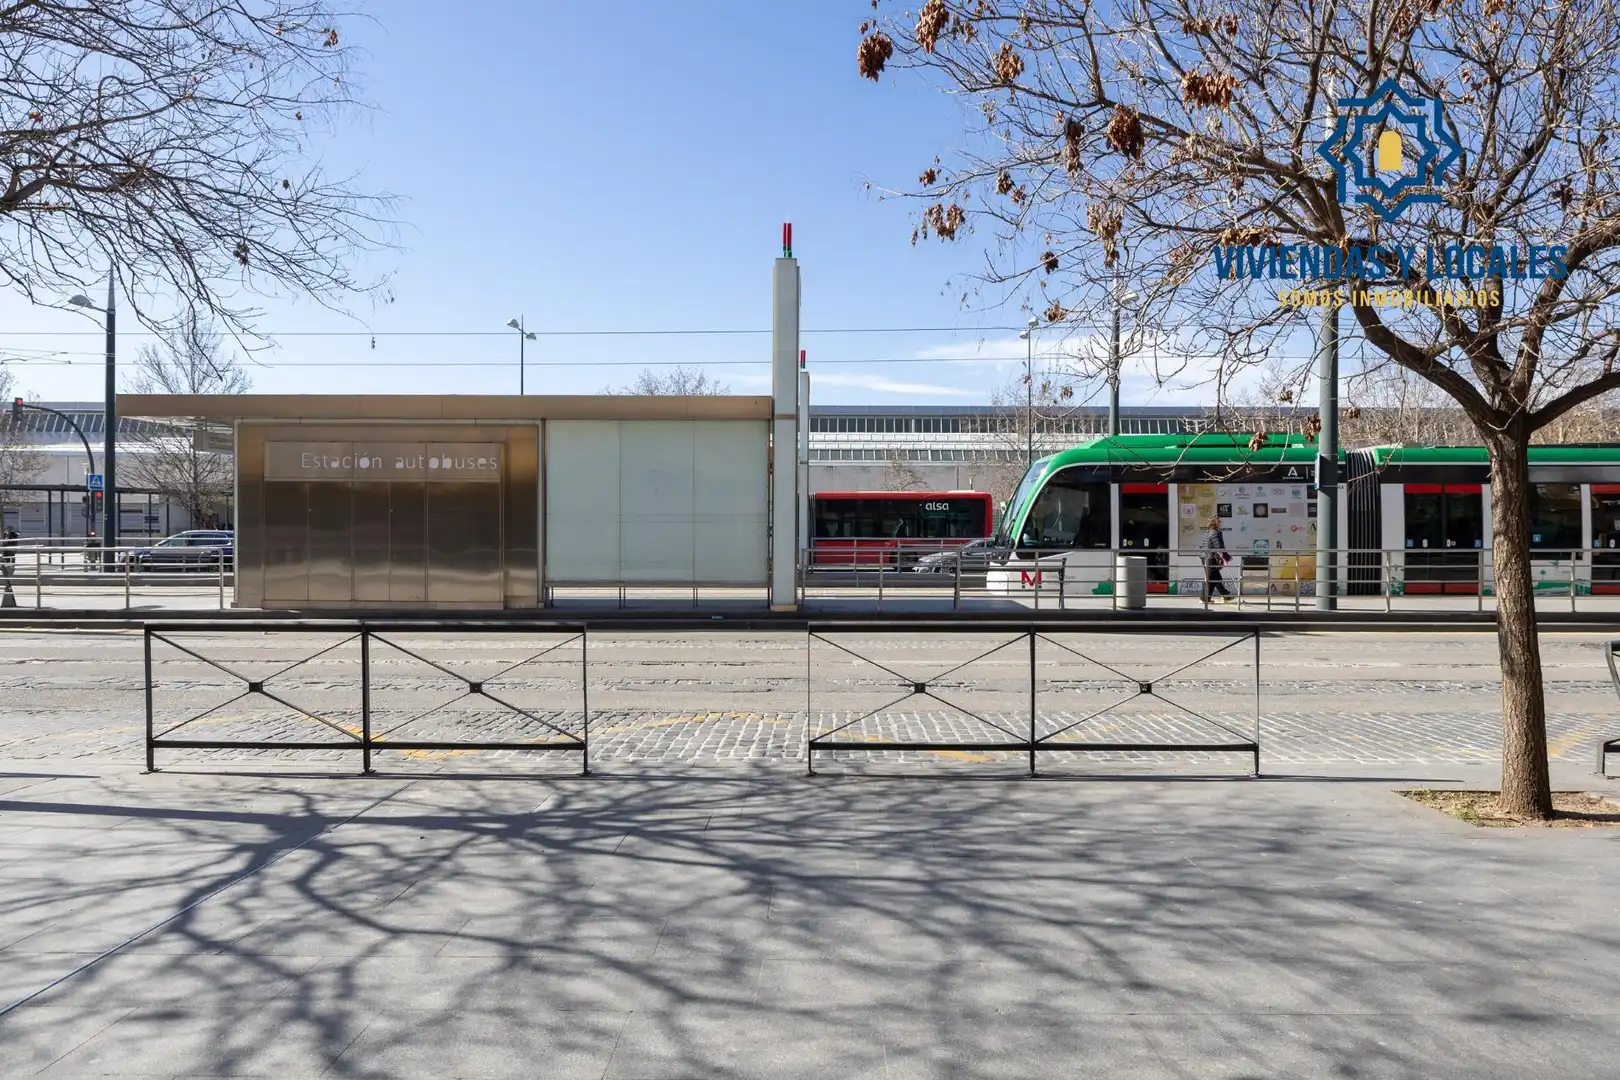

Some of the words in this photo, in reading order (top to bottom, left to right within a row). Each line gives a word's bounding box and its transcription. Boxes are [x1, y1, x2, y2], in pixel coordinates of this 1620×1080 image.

[300, 450, 383, 470] Estación
[394, 453, 499, 470] autobuses
[925, 502, 949, 512] alsa
